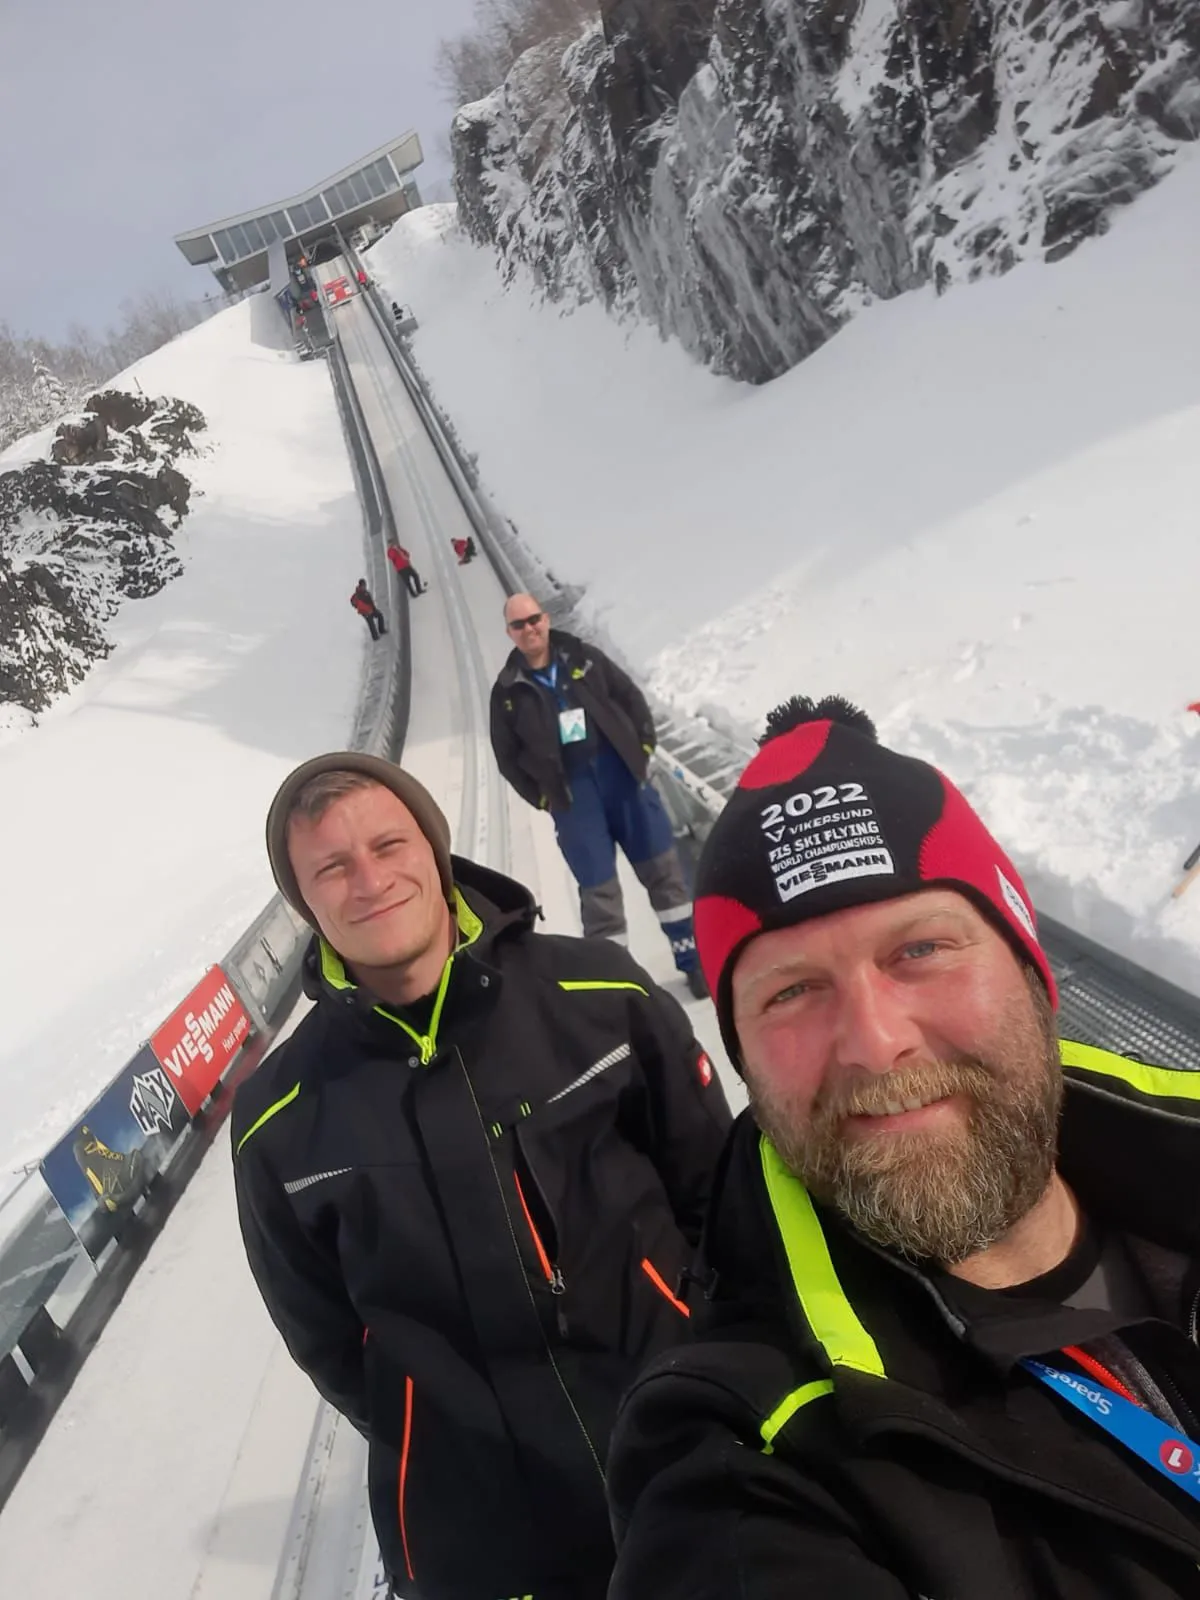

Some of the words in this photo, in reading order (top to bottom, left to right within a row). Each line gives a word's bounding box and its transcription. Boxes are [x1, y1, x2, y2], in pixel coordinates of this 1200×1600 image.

[761, 783, 868, 829] 2022
[790, 808, 873, 835] VIKERSUND
[769, 844, 792, 862] FIS
[794, 833, 822, 852] SKI
[824, 821, 880, 842] FLYING
[770, 854, 803, 873] WORLD
[804, 835, 884, 860] CHAMPIONSHIPS
[779, 854, 888, 891] VIESSMANN
[163, 983, 236, 1078] VIESSMANN
[1167, 1447, 1184, 1468] 1
